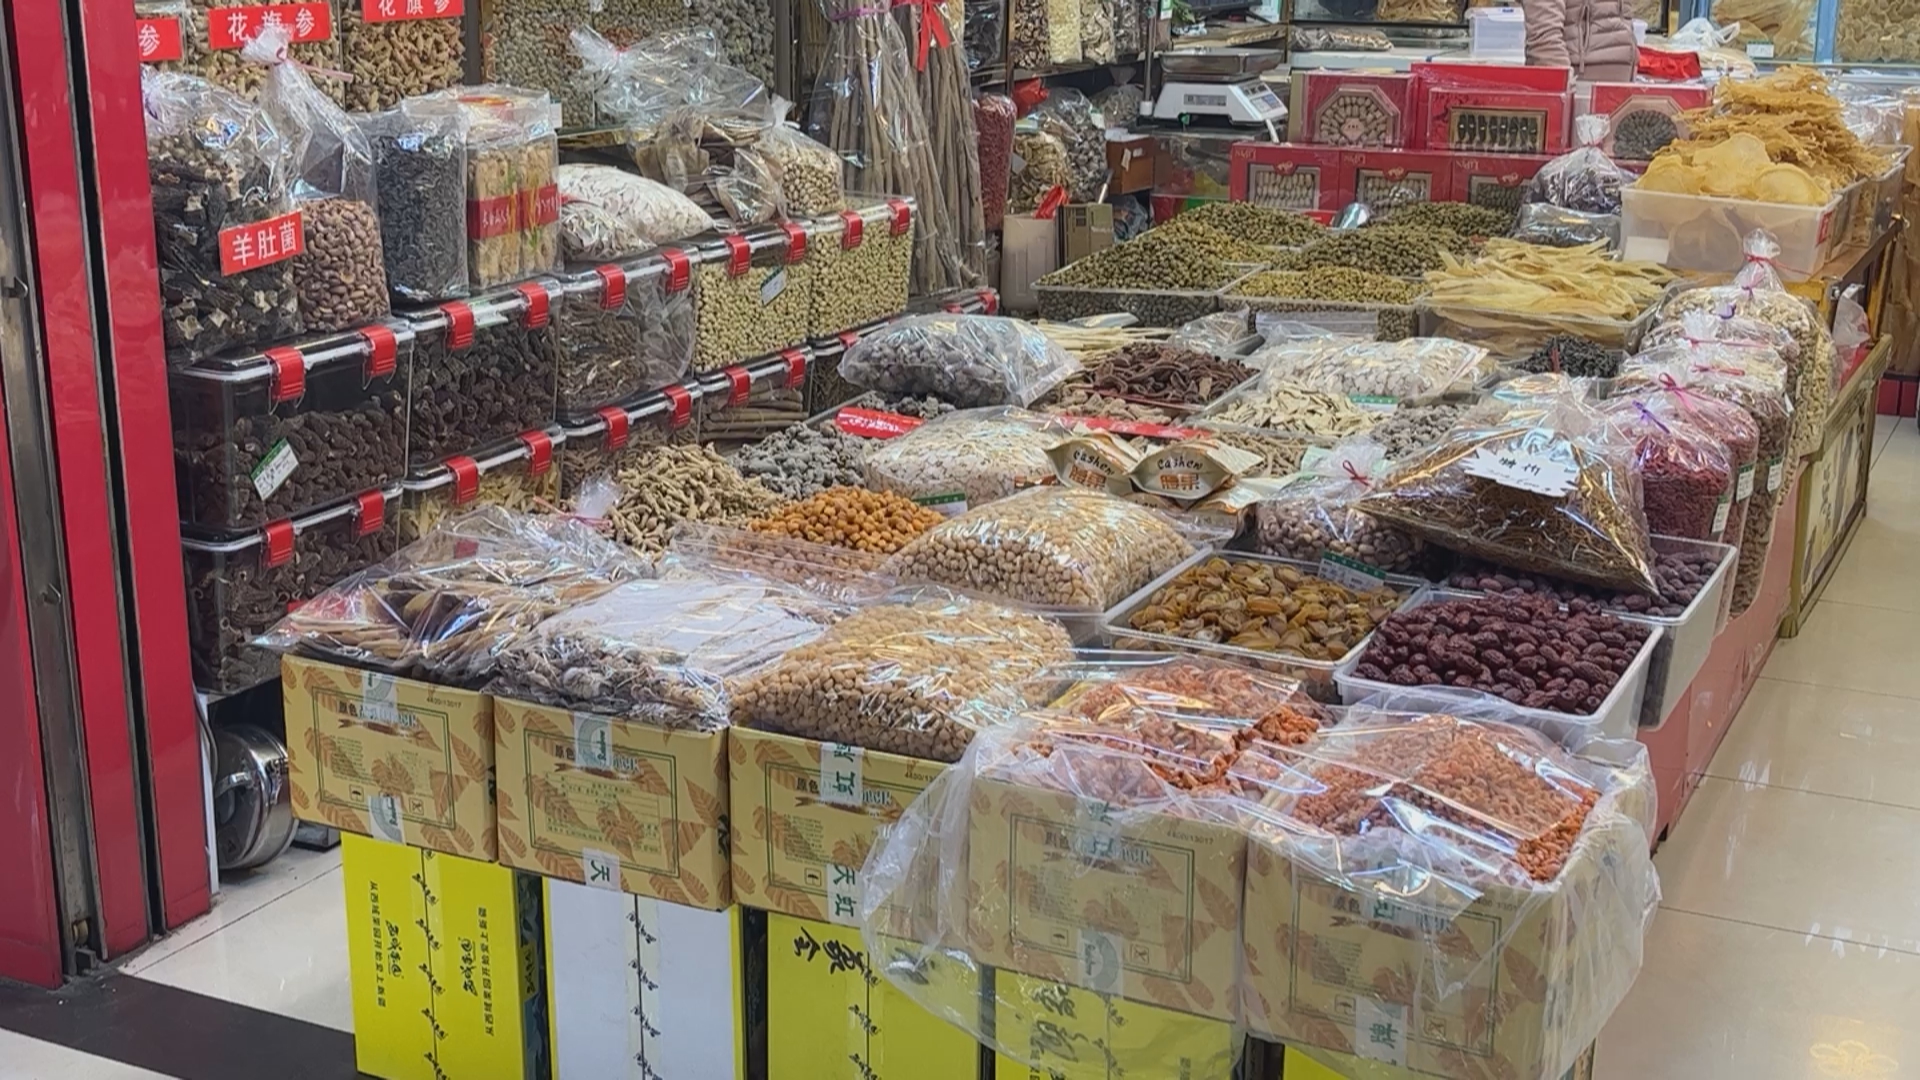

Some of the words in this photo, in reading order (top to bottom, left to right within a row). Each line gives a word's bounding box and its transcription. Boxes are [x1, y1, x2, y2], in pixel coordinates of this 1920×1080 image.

[138, 23, 160, 57] 参
[232, 220, 296, 266] 羊肚菌
[591, 859, 610, 882] 天
[833, 864, 857, 918] 天虹
